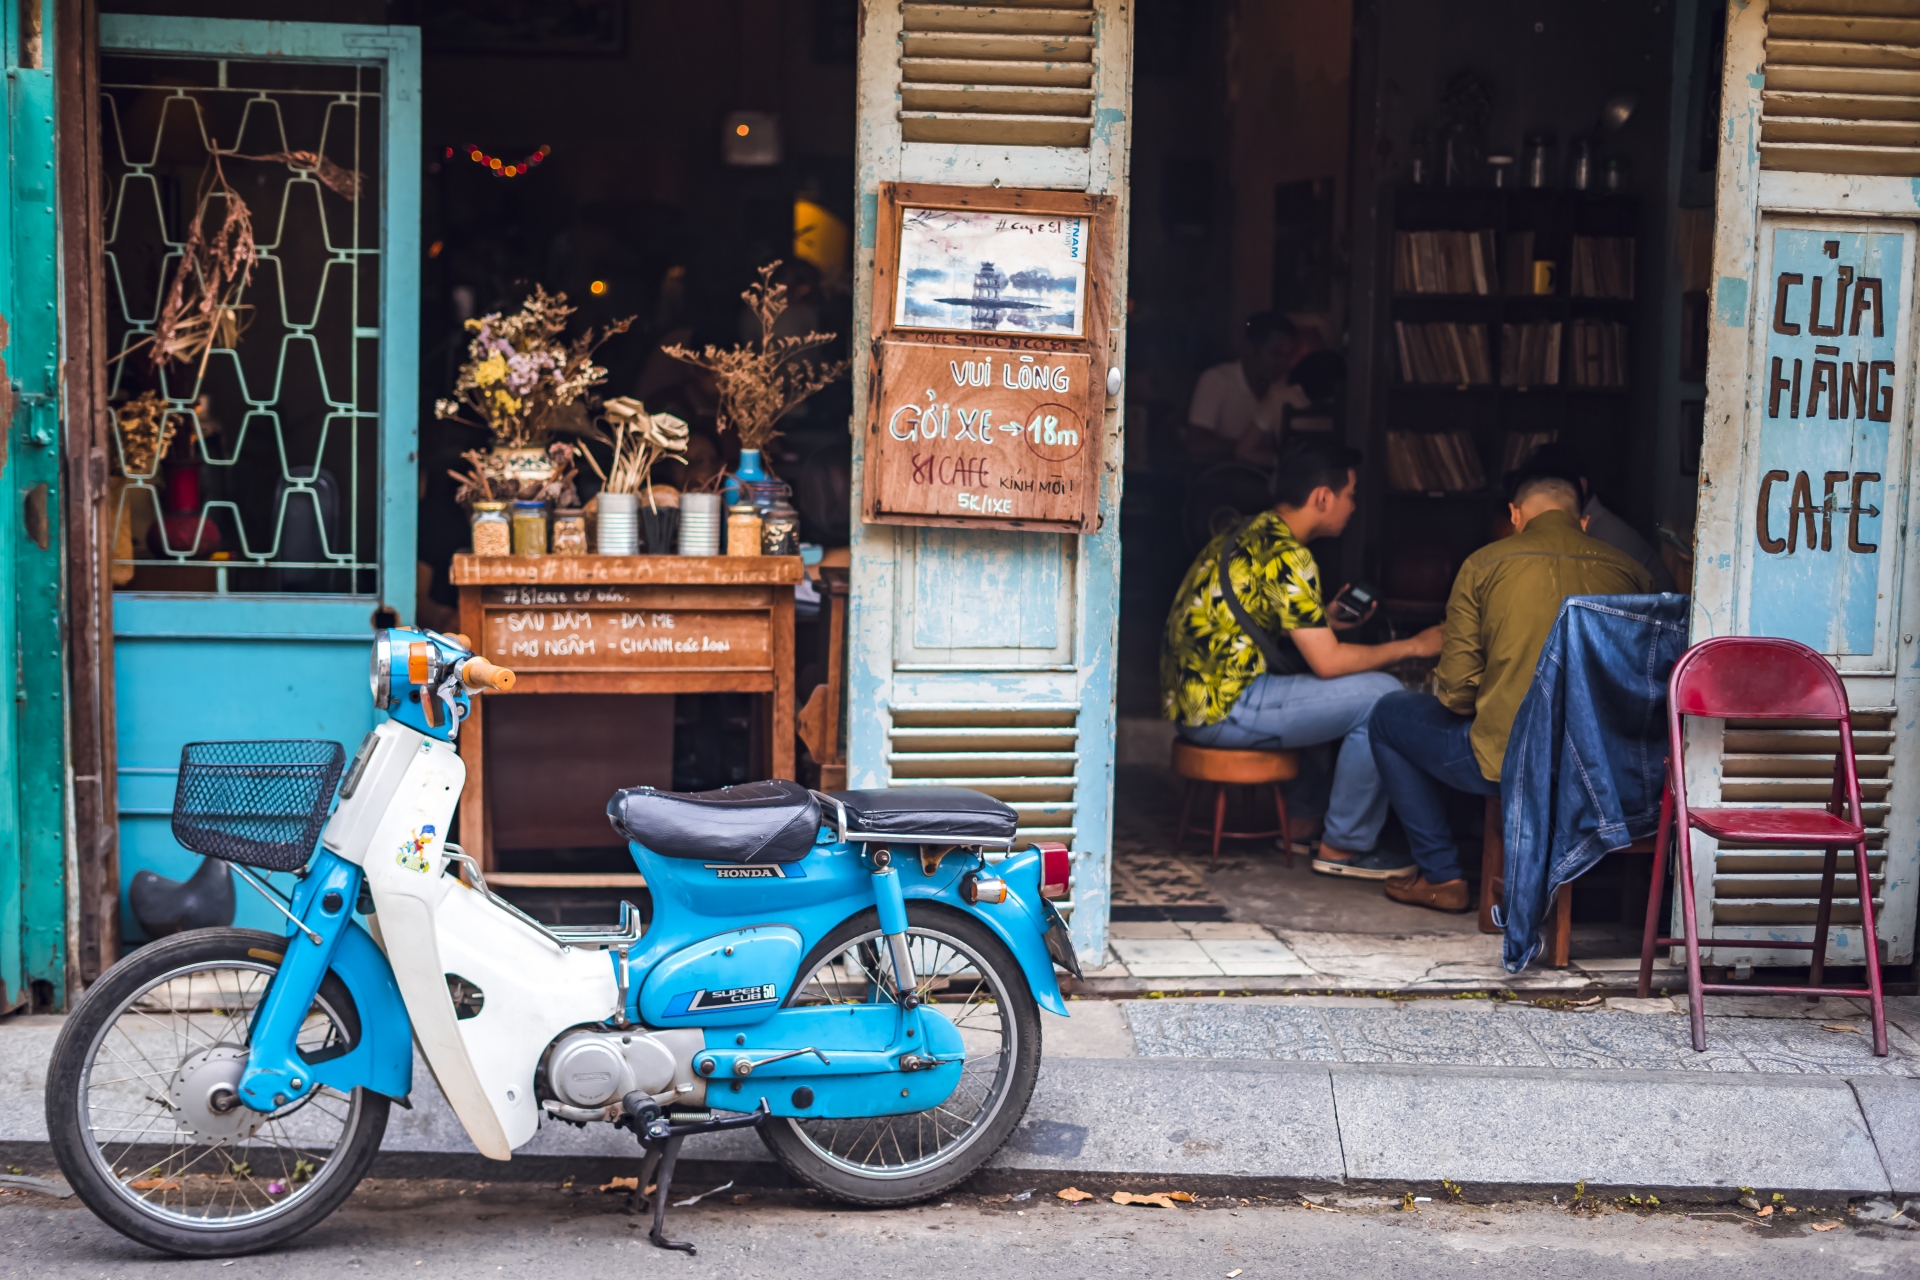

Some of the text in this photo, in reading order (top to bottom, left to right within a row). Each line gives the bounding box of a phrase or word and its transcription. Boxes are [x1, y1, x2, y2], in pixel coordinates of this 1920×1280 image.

[954, 407, 994, 445] XE
[1027, 414, 1079, 446] 18m
[1756, 469, 1881, 555] CAFE
[717, 868, 773, 878] HONDA
[712, 983, 776, 999] SUPER 50
[730, 993, 761, 1003] CUB
